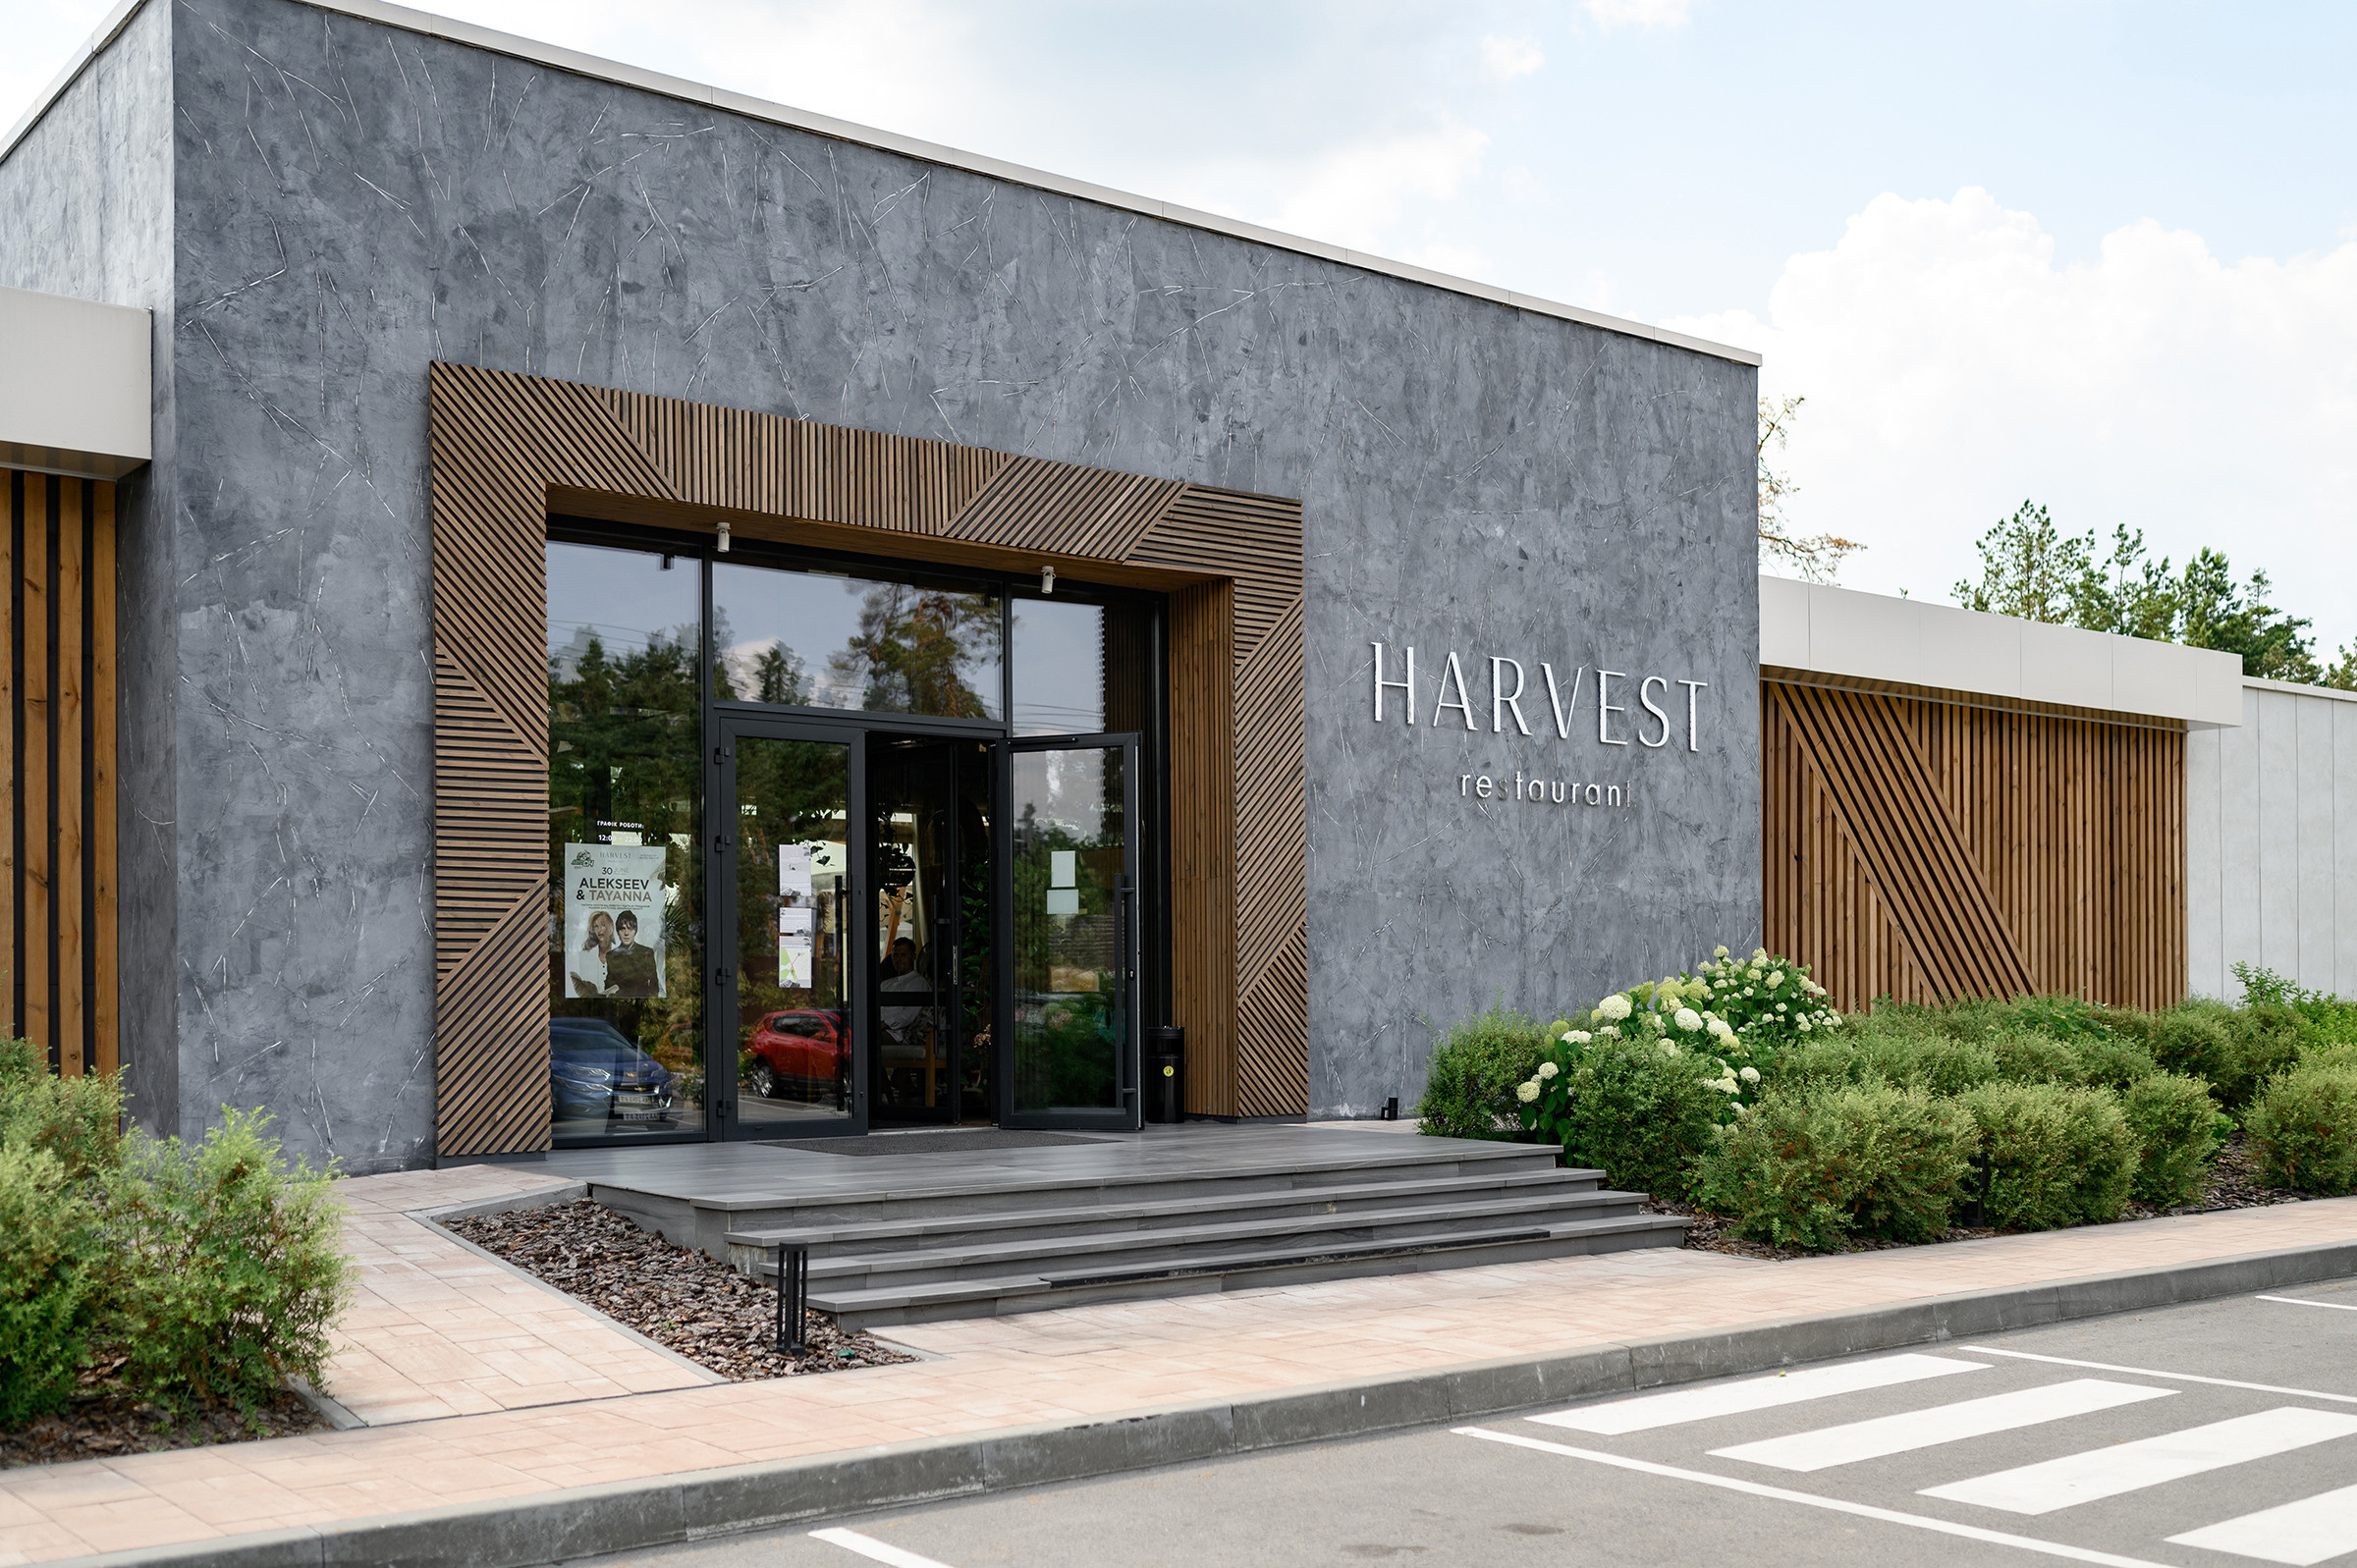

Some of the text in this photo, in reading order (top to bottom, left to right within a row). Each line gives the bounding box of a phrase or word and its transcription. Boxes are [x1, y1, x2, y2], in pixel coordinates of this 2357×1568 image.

[1370, 641, 1709, 752] HARVEST
[601, 866, 614, 875] 30
[579, 878, 649, 890] ALEKSEEV
[576, 890, 652, 901] & TAYANNA
